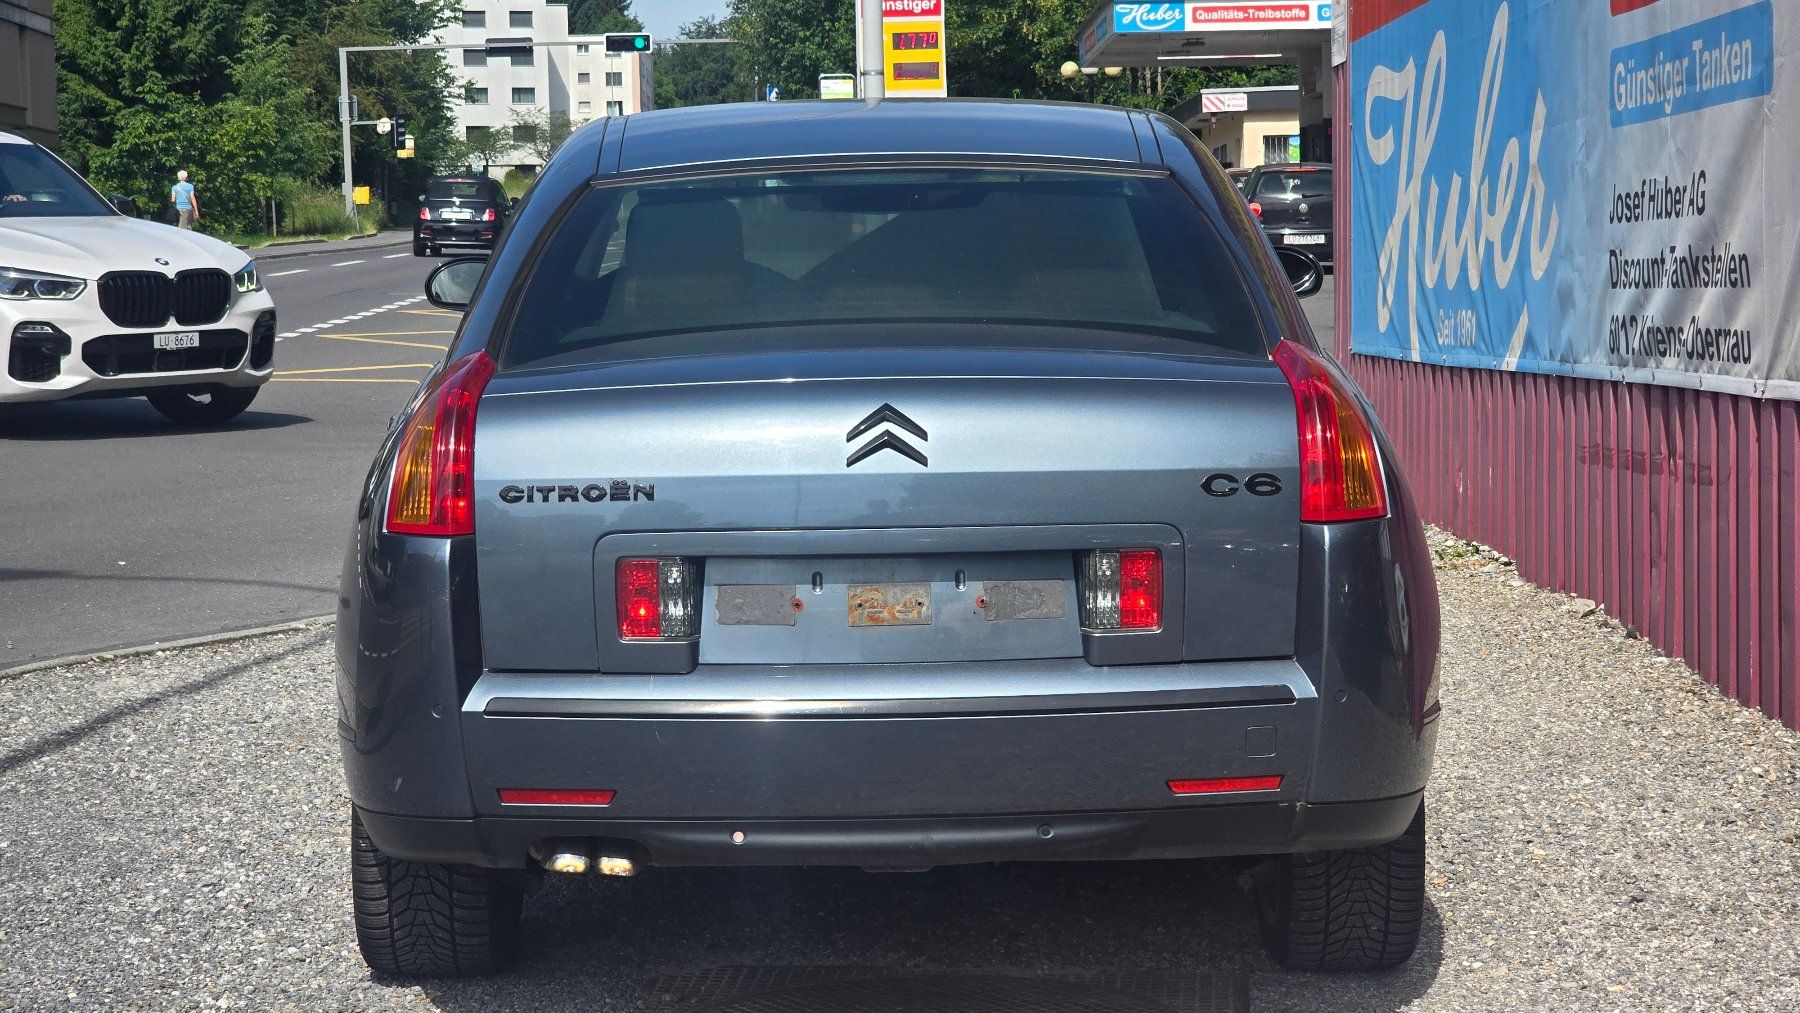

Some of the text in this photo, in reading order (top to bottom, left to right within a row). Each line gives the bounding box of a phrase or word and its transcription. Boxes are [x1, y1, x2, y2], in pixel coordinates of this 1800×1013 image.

[1115, 3, 1183, 30] Huber
[1195, 7, 1306, 20] Qualitäts-Treibstoffe
[1321, 7, 1331, 17] G
[1613, 31, 1753, 114] Günstiger Tanken
[1364, 3, 1560, 371] Huber
[1609, 169, 1707, 225] Josef Huber AG
[1609, 242, 1751, 290] Discount-Tankstellen
[1437, 308, 1476, 347] Seit 1961
[1609, 314, 1752, 365] 6012 Kriens-Obernau
[498, 479, 655, 504] CITROËN
[1200, 472, 1283, 497] C6
